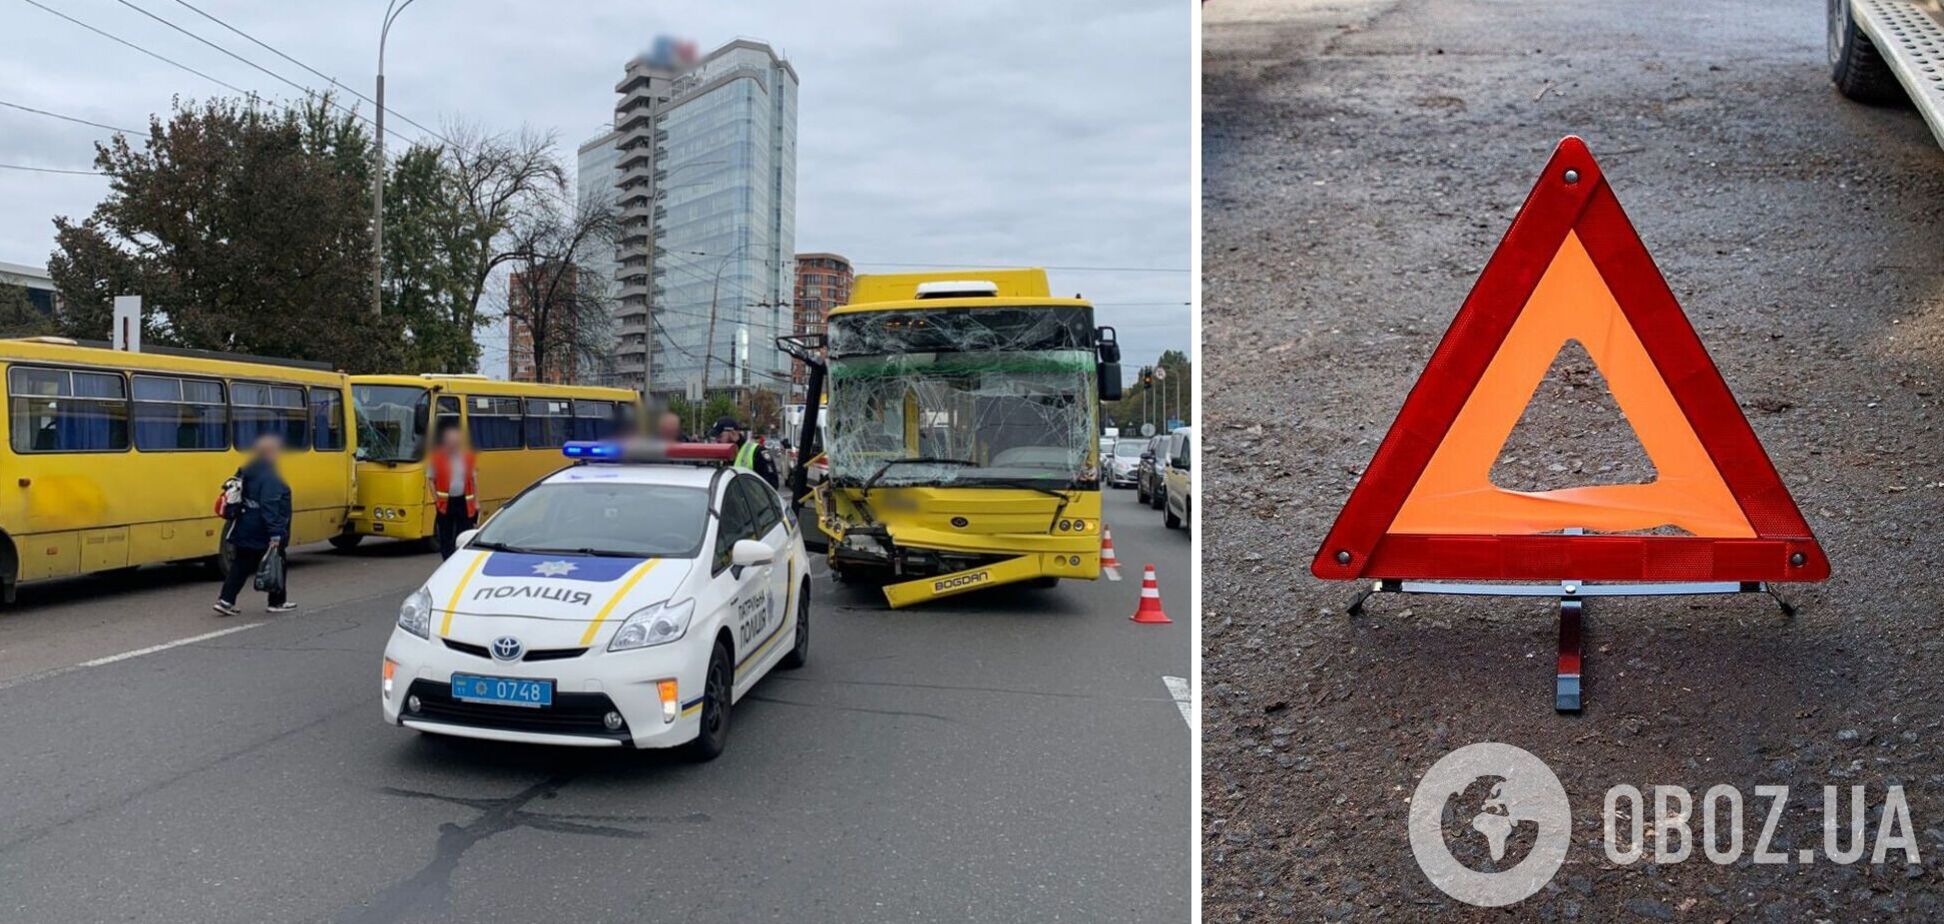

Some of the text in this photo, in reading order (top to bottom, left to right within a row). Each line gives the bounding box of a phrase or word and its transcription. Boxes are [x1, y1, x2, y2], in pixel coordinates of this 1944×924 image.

[935, 571, 988, 591] BOGDAN
[473, 586, 592, 605] ПОЛІЦІЯ
[497, 682, 541, 701] 0748
